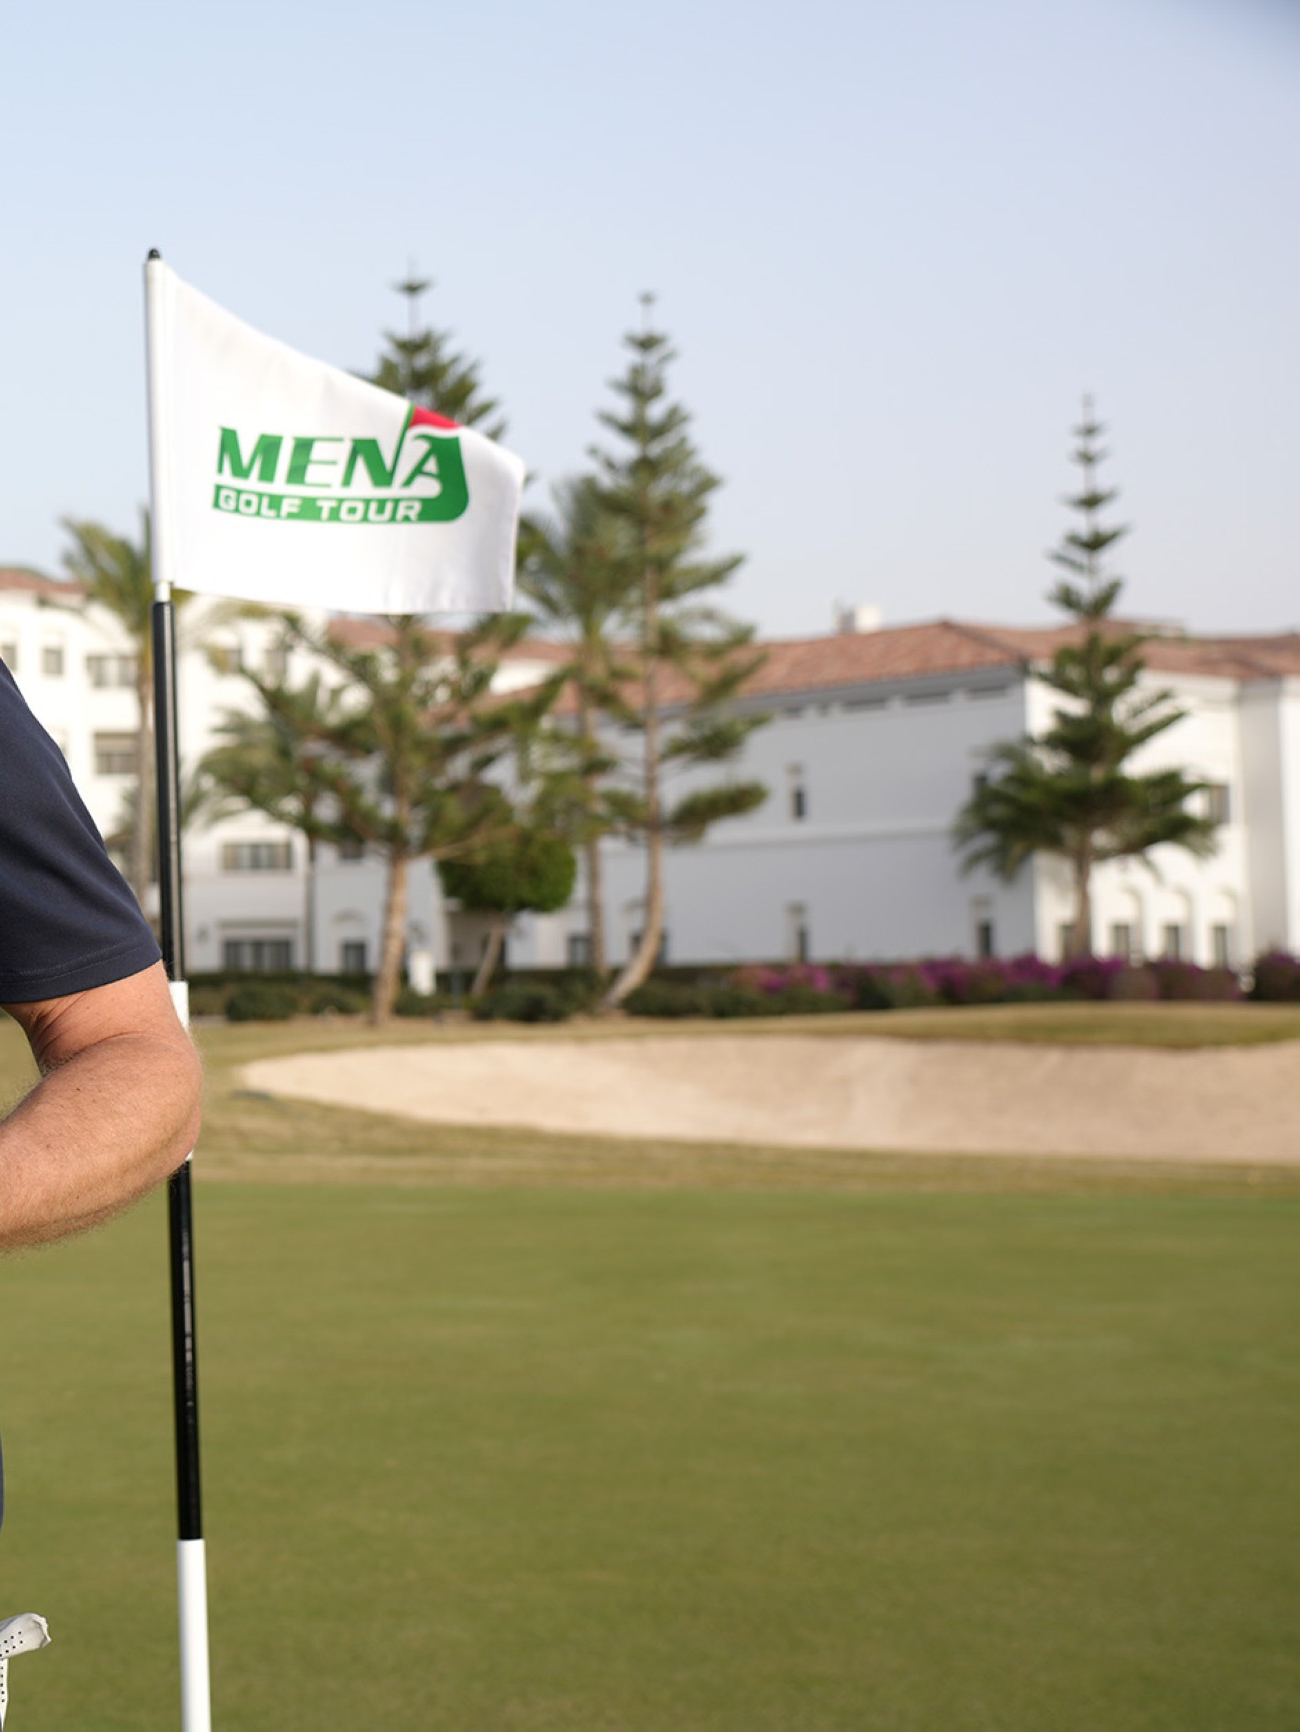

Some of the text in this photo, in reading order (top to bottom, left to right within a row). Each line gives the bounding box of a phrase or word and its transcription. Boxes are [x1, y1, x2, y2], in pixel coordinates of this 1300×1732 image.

[217, 402, 468, 489] MENA
[219, 488, 422, 522] GOLF TOUR
